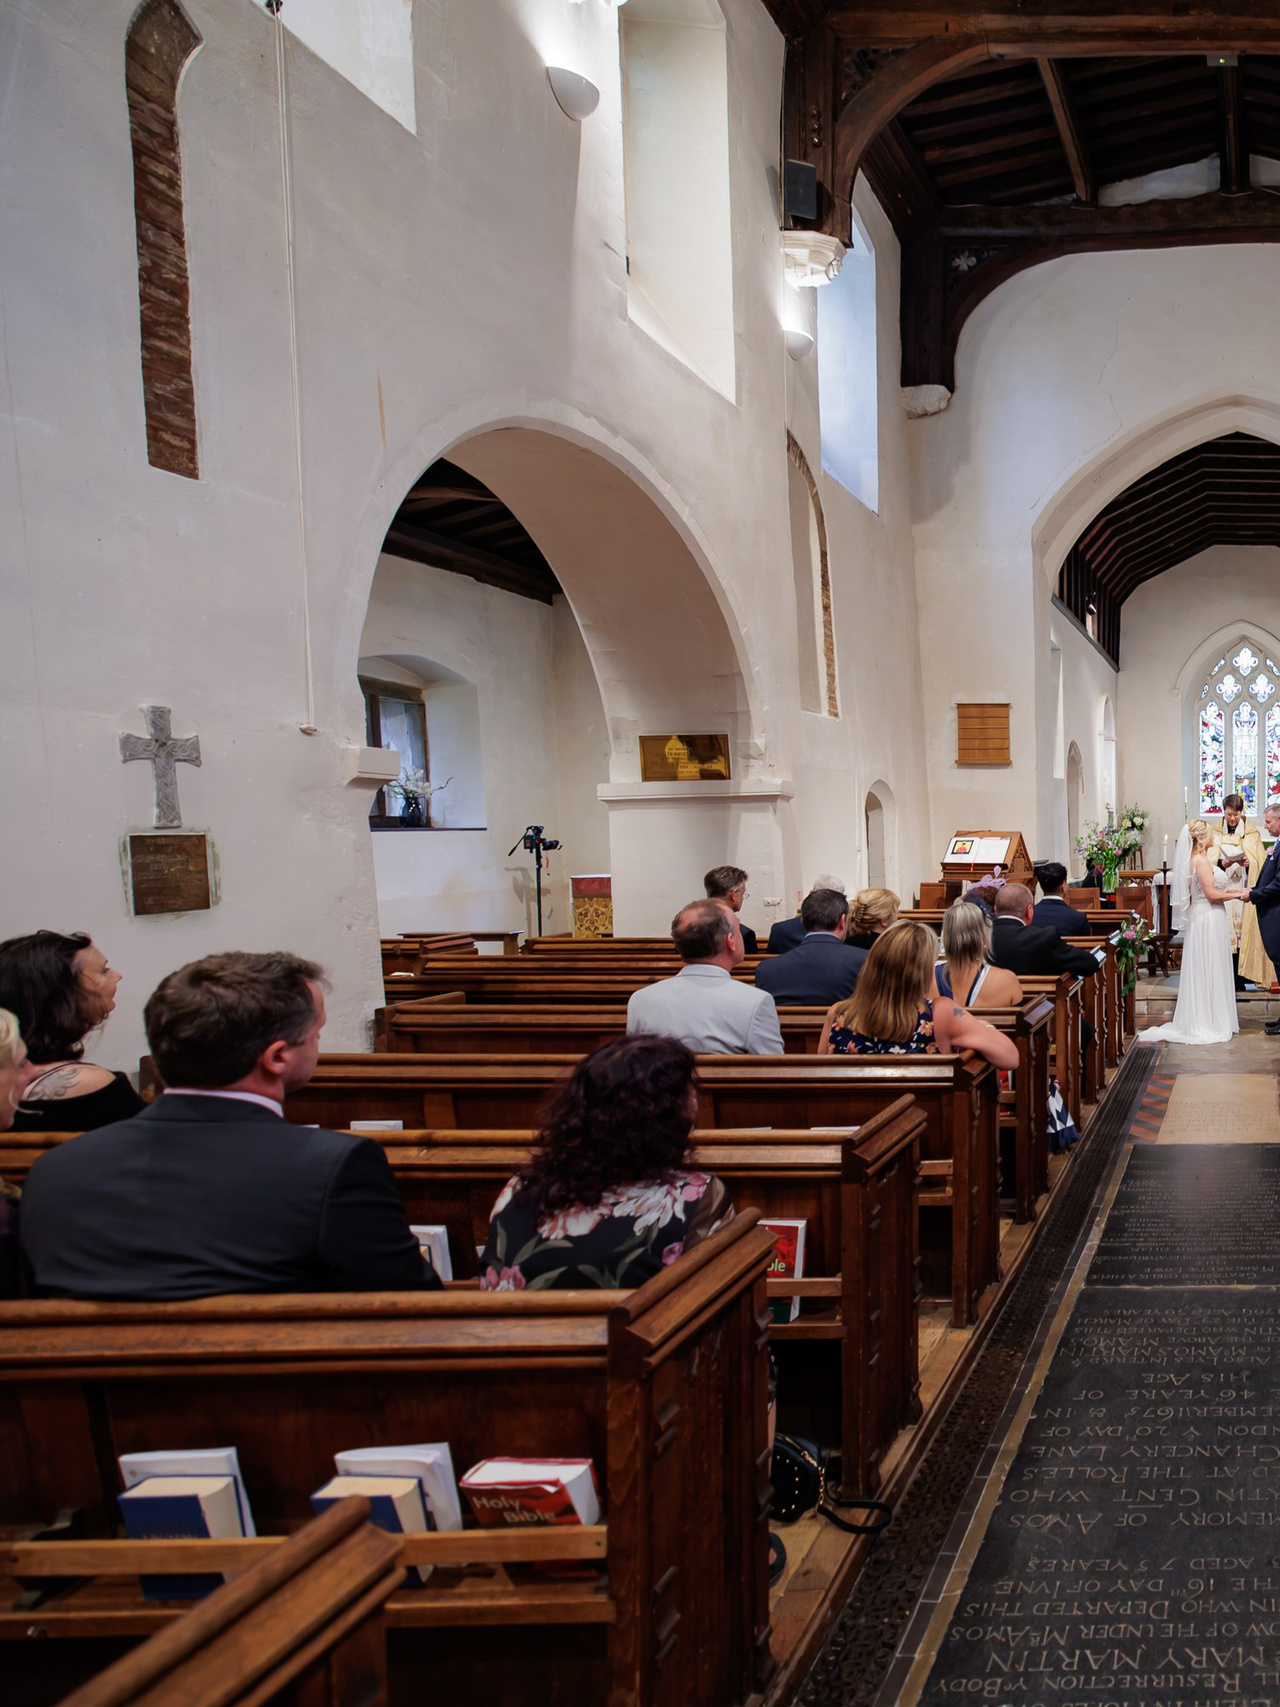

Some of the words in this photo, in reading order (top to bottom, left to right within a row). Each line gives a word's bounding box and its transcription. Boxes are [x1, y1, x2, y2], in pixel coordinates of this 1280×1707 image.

[1070, 1336, 1133, 1346] AMOS
[1059, 1347, 1151, 1358] MARTIN
[1157, 1346, 1223, 1357] AMOS
[1141, 1373, 1191, 1386] AGE
[1201, 1372, 1247, 1383] HIS
[1072, 1389, 1104, 1401] OF
[1124, 1389, 1211, 1400] YEARE
[1043, 1407, 1072, 1419] IN
[1040, 1426, 1071, 1437] OF
[1078, 1425, 1123, 1437] DAY
[1030, 1445, 1111, 1462] LANE
[1120, 1444, 1280, 1462] CHANCERY
[1022, 1466, 1129, 1484] ROLLES
[1136, 1466, 1191, 1478] THE
[1205, 1465, 1240, 1478] AT
[473, 1496, 520, 1510] Holy
[1009, 1489, 1091, 1503] WHO
[1112, 1488, 1200, 1508] GENT
[503, 1510, 557, 1524] Bible
[1008, 1513, 1104, 1535] AMOS
[1114, 1513, 1148, 1527] OF
[1026, 1557, 1128, 1572] YEARES
[1188, 1557, 1255, 1570] AGED
[1066, 1579, 1101, 1593] OF
[1109, 1578, 1164, 1592] DAY
[1230, 1577, 1278, 1591] THE
[964, 1602, 1024, 1617] THIS
[1032, 1600, 1169, 1620] DEPARTED
[1181, 1599, 1240, 1613] WHO
[949, 1625, 1030, 1647] AMOS
[1079, 1623, 1154, 1639] UNDER
[1205, 1621, 1238, 1637] OF
[986, 1648, 1141, 1672] MARTIN
[1155, 1646, 1267, 1669] MARY
[931, 1677, 1003, 1698] BODY
[1042, 1673, 1241, 1694] RESURRECTION
